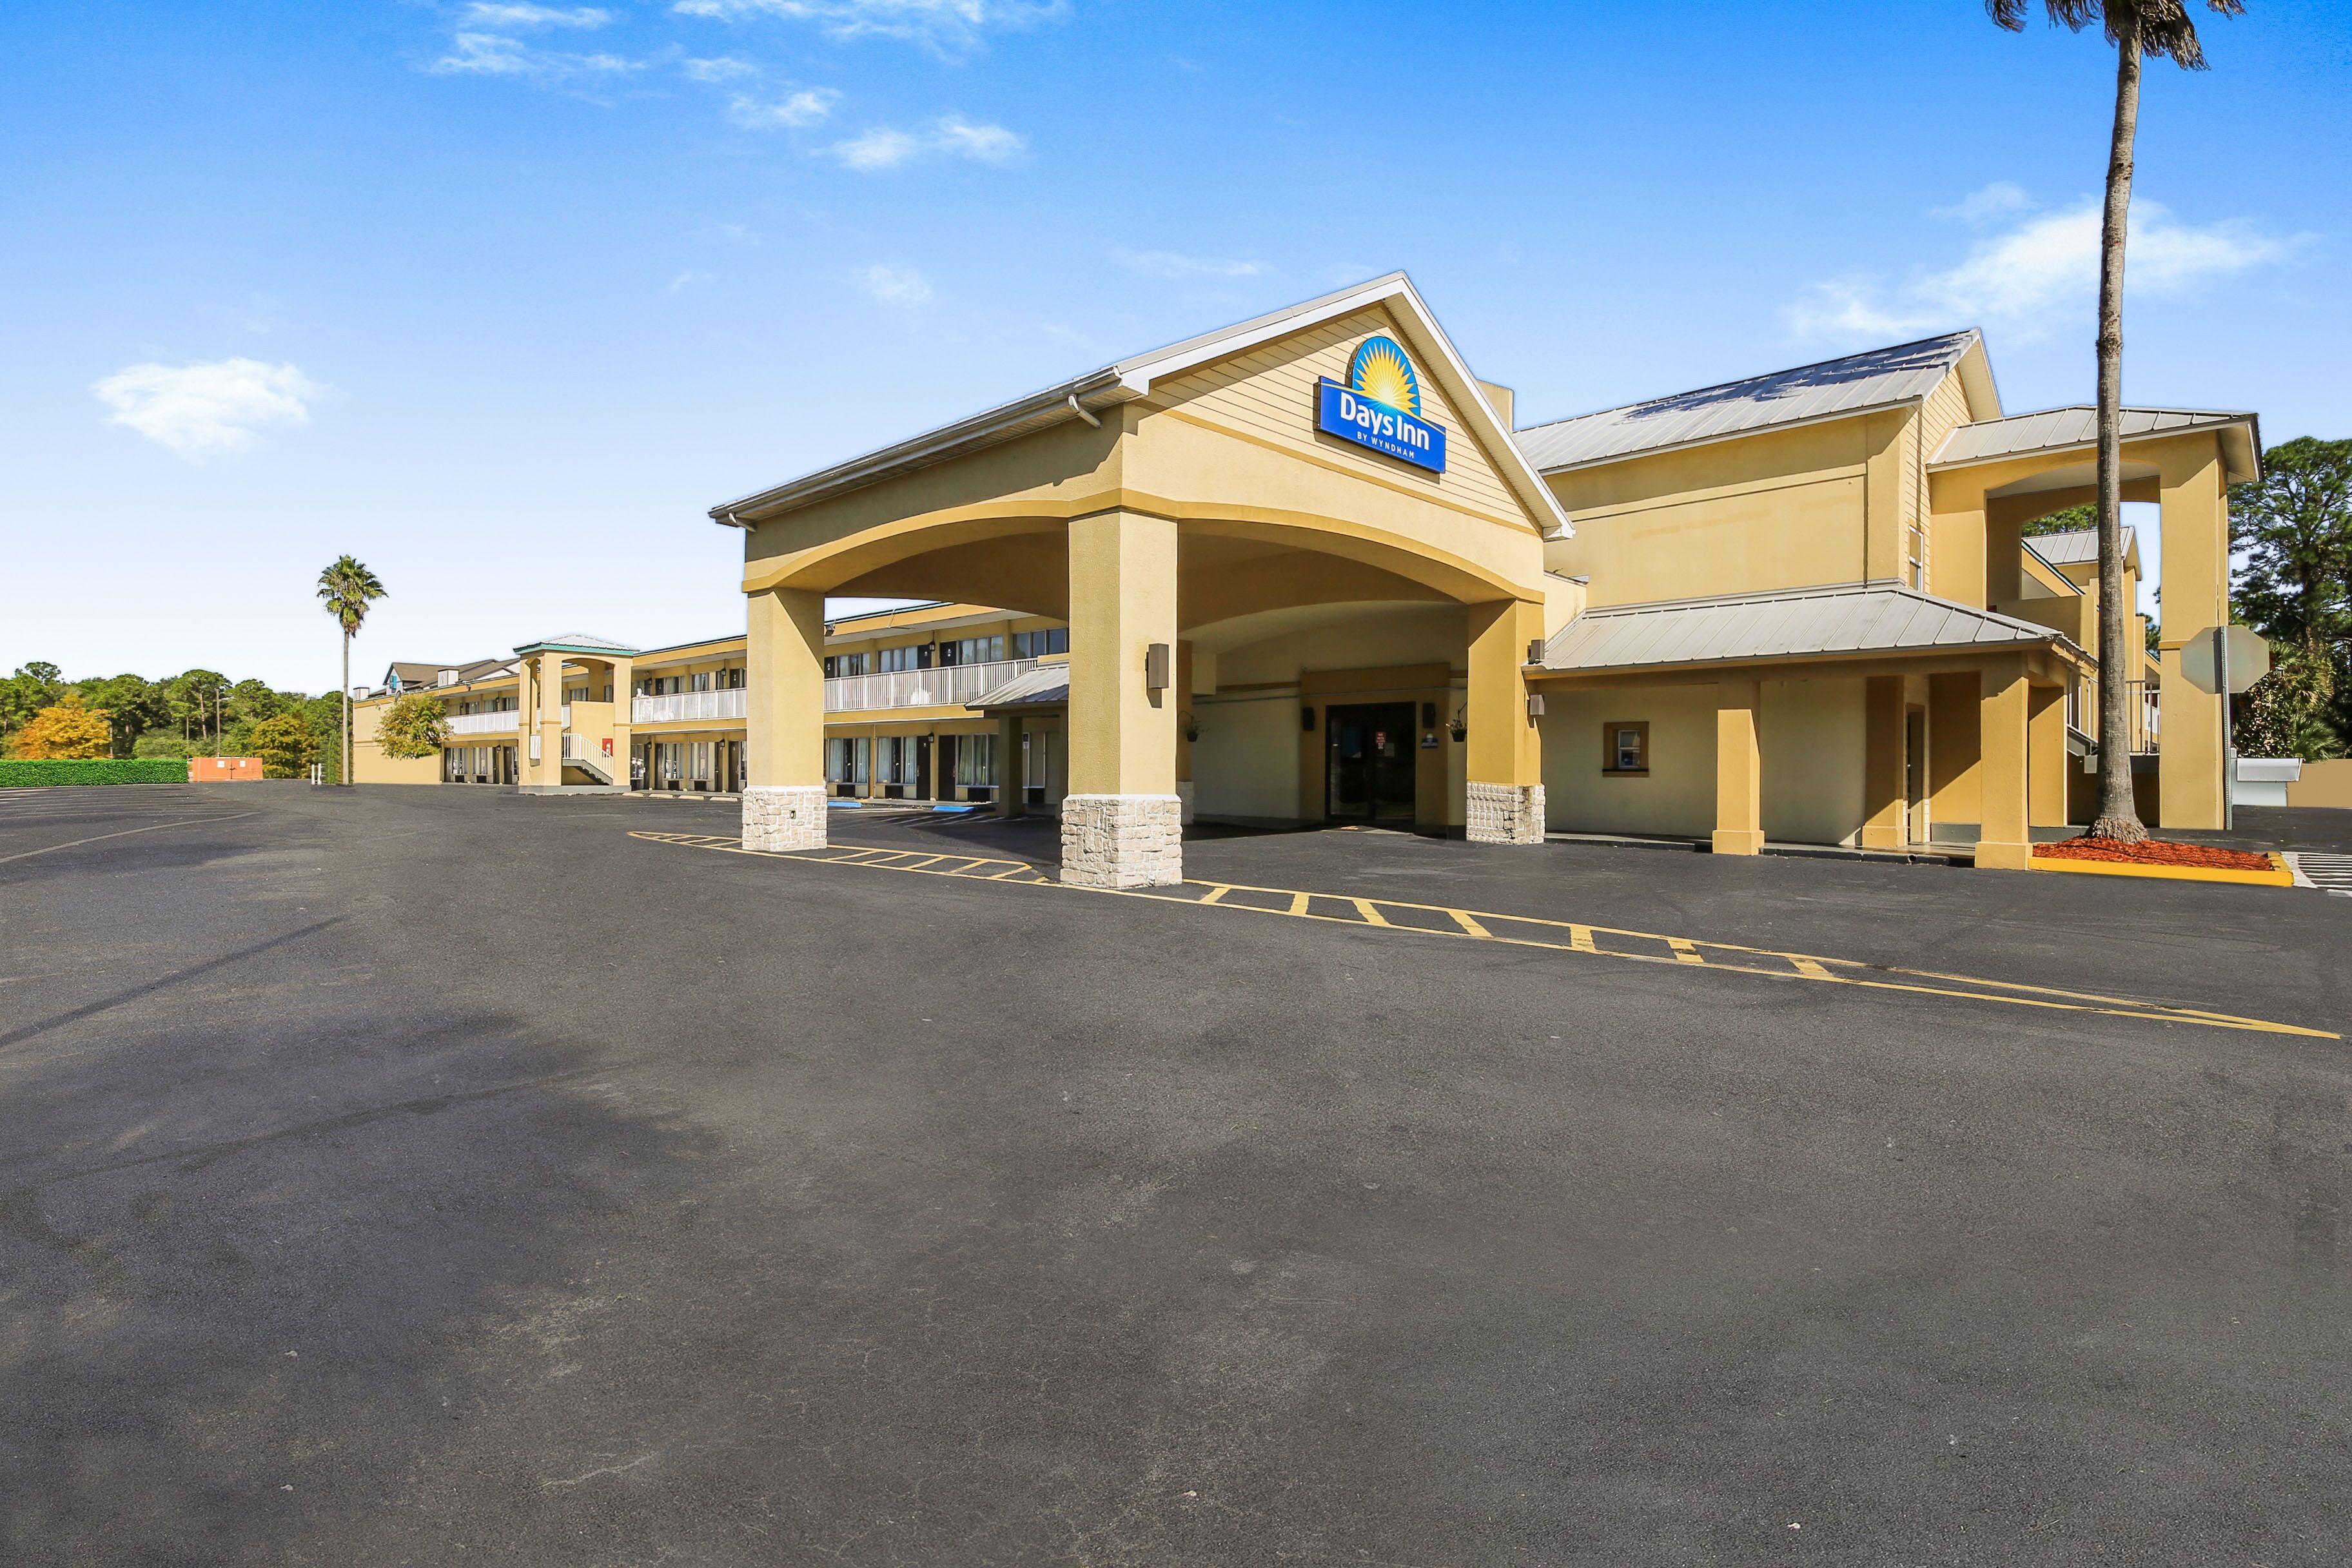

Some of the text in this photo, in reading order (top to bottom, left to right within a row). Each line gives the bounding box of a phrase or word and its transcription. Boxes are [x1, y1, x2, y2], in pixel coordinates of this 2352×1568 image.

[1340, 391, 1429, 451] Days Inn
[1357, 431, 1415, 458] BY WYNDHAM
